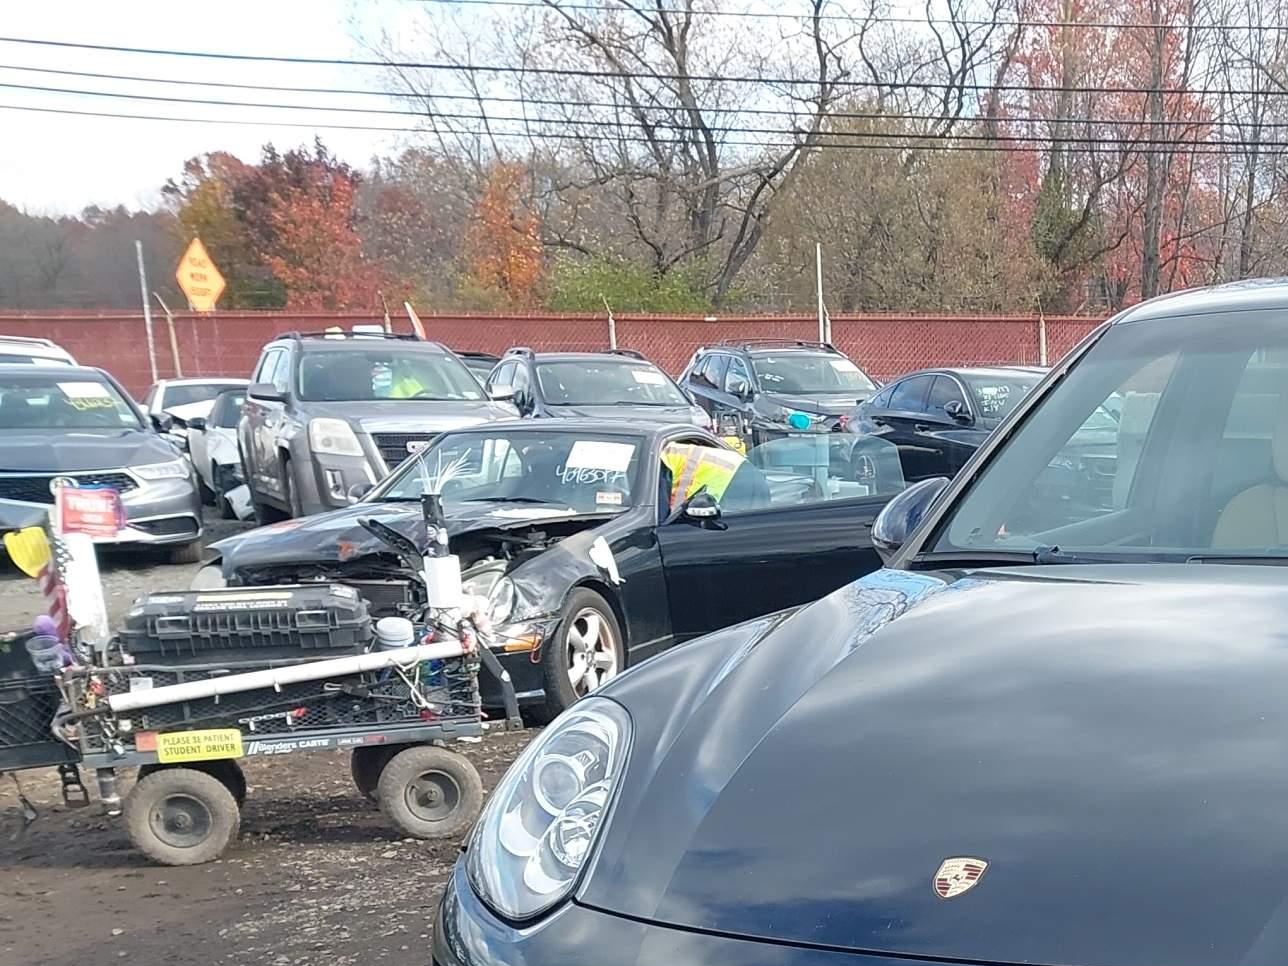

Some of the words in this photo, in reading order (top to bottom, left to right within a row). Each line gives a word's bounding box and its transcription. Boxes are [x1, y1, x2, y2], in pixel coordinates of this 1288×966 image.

[163, 737, 191, 746] PLEASE
[203, 733, 234, 742] PATIENT
[164, 745, 201, 756] STUDENT
[205, 743, 236, 753] DRIVER
